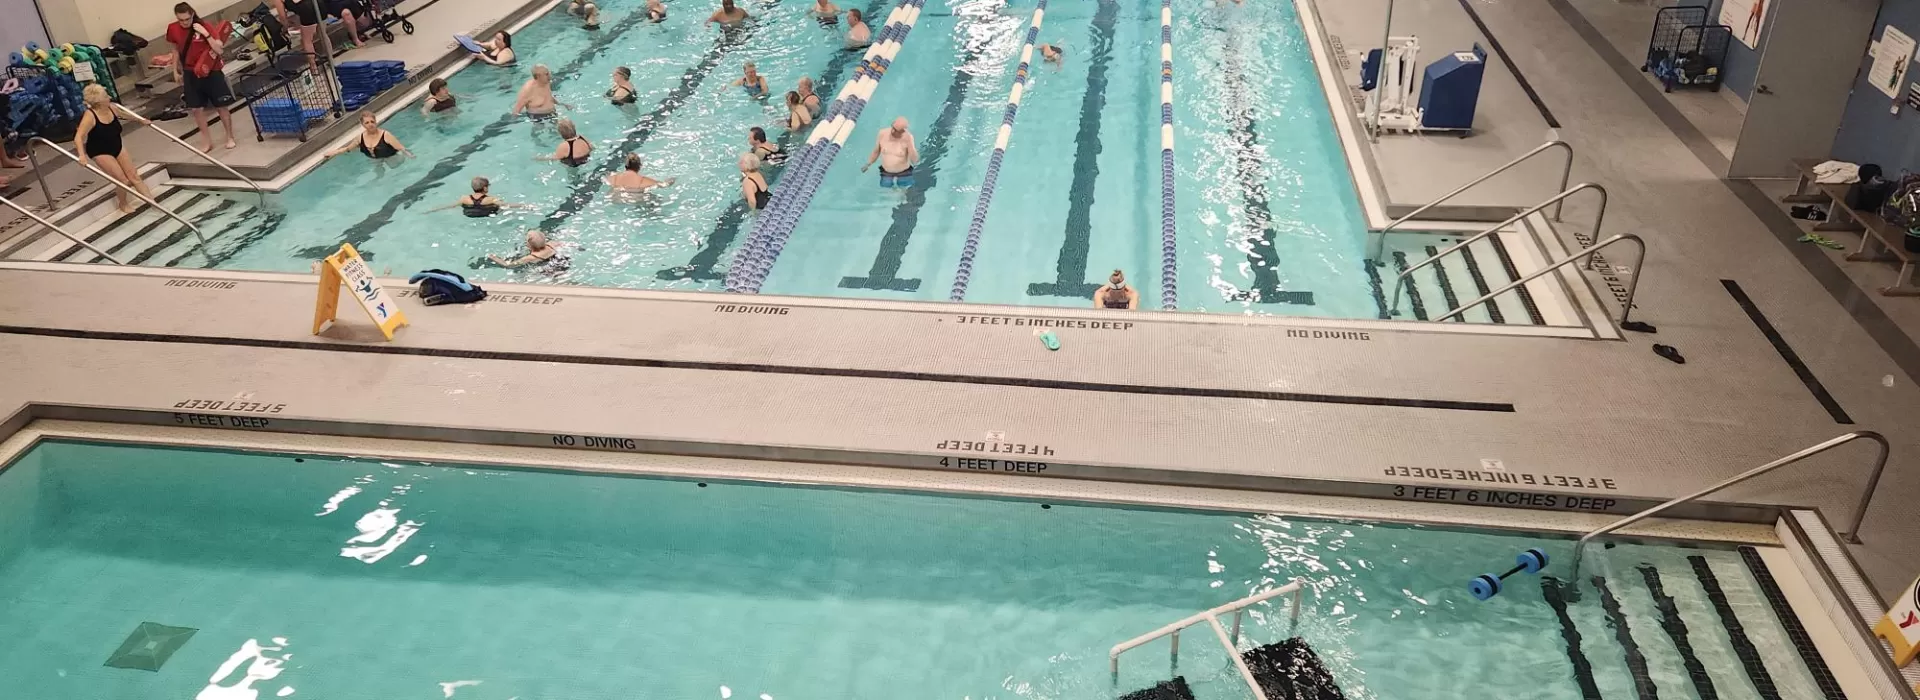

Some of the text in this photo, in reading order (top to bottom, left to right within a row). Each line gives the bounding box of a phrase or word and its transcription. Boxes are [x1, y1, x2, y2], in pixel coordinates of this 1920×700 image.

[344, 259, 358, 272] WATER
[346, 264, 363, 278] FITNESS
[352, 270, 365, 282] CLASS
[164, 279, 238, 289] NO DIVING
[521, 296, 564, 305] DEEP
[714, 304, 790, 315] NO DIVING
[956, 315, 1134, 330] 3 FEET 6 INCHES DEEP
[1286, 329, 1371, 341] NO DIVING
[173, 399, 287, 413] 5 FEET DEEP
[173, 412, 270, 428] 5 FEET DEEP
[552, 435, 637, 450] NO DIVING
[936, 439, 1055, 456] 4 FEET DEEP
[939, 456, 1048, 473] 4 FEET DEEP
[1521, 473, 1537, 485] 6
[1542, 475, 1599, 489] FEET
[1600, 478, 1618, 490] 3
[1393, 484, 1616, 511] 3 FEET 6 INCHES DEEP
